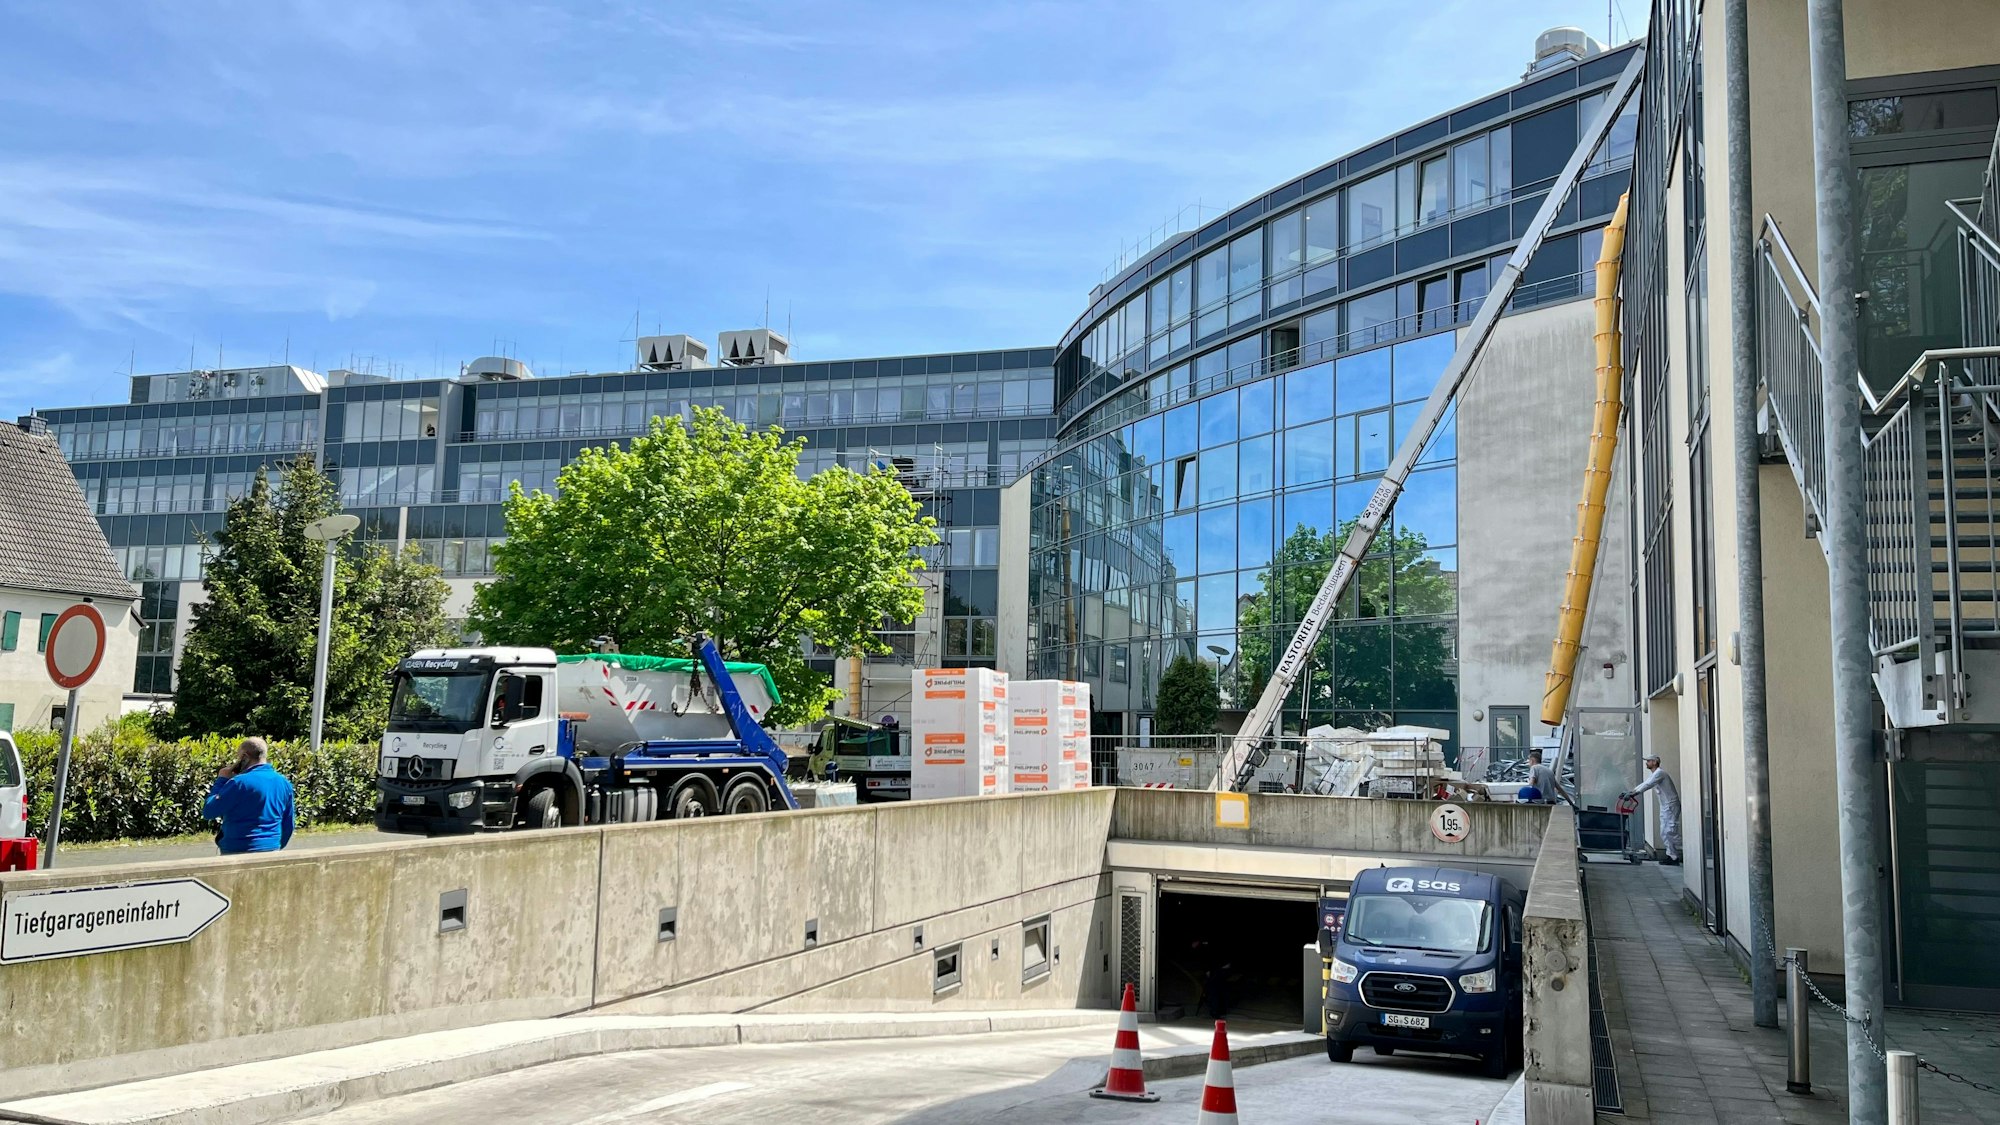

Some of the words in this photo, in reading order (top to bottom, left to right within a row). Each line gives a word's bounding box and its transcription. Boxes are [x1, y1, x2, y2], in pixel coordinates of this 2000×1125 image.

[1280, 618, 1315, 673] RASTORFER
[1311, 560, 1347, 616] Bedachungen
[425, 660, 459, 670] Recycling
[423, 742, 447, 750] Recycling
[387, 760, 394, 775] A
[1417, 880, 1461, 892] sas
[15, 899, 180, 938] Tiefgarageneinfahrt
[1388, 1015, 1399, 1024] SG
[1404, 1016, 1409, 1025] S
[1410, 1017, 1426, 1026] 682
